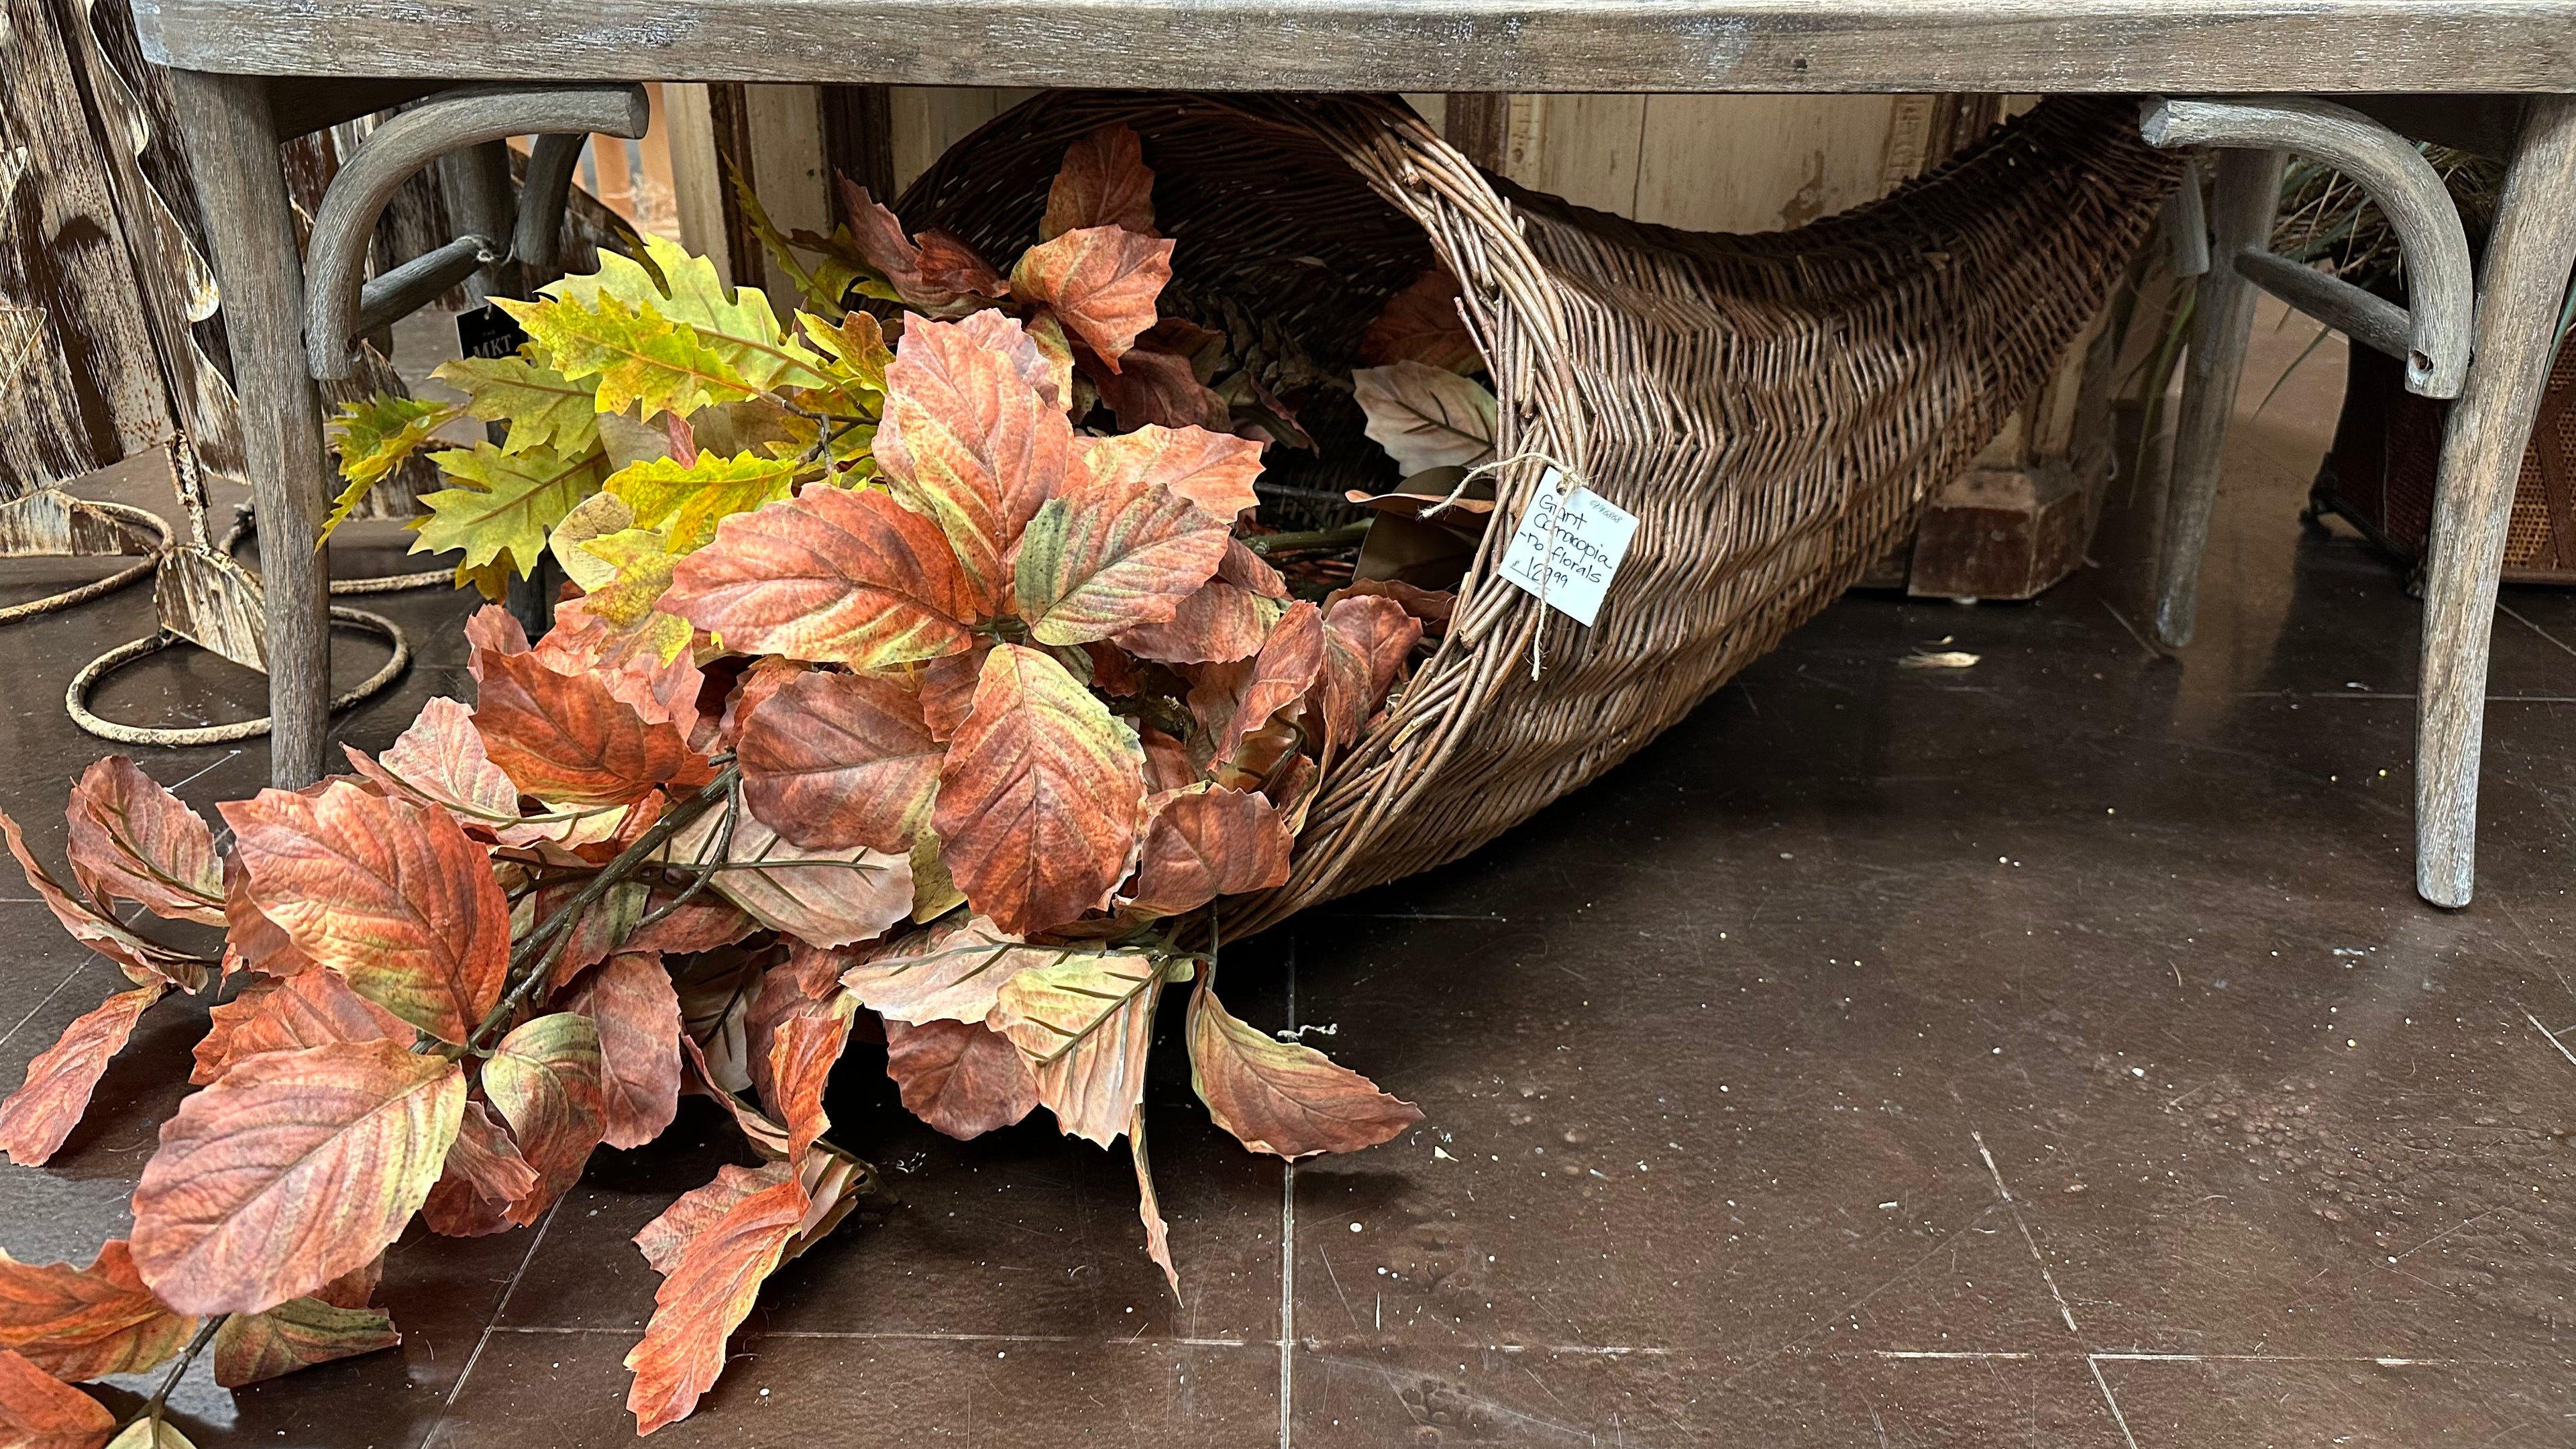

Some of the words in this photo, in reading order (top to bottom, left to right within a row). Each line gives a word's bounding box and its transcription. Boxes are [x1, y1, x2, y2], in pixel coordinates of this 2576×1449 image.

[472, 334, 512, 358] MKT
[1539, 494, 1587, 530] Giant
[1551, 546, 1602, 583] florals
